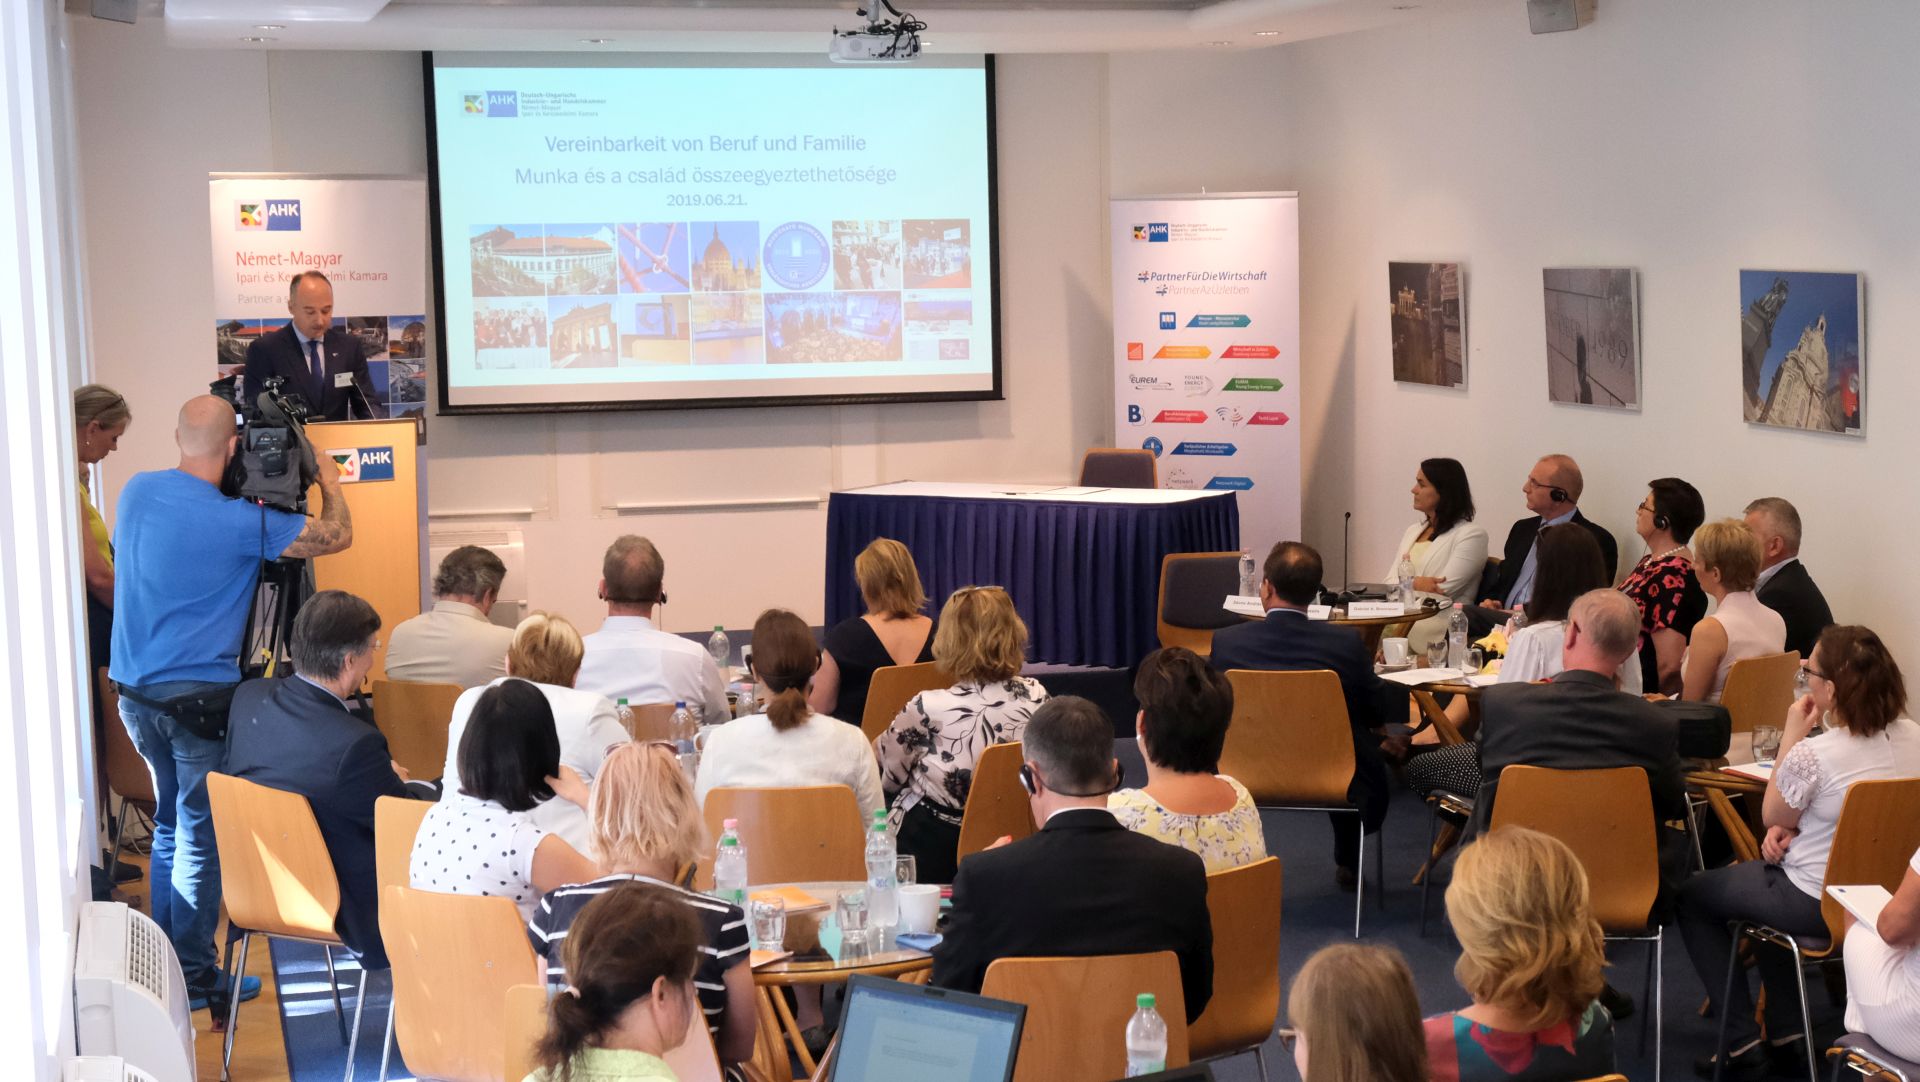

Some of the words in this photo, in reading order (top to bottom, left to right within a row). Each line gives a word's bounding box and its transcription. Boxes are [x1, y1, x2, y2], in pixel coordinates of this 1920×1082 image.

[489, 95, 516, 105] AHK
[544, 135, 667, 154] Vereinbarkeit
[671, 139, 704, 153] von
[709, 134, 758, 152] Beruf
[763, 134, 797, 152] und
[803, 134, 867, 151] Familie
[515, 168, 578, 185] Munka
[584, 166, 606, 184] és
[611, 171, 622, 184] a
[628, 165, 687, 184] család
[692, 164, 897, 188] összeegyeztethetősége
[666, 193, 748, 207] 2019.06.21.
[268, 203, 299, 217] AHK
[1150, 225, 1168, 233] AHK
[236, 250, 344, 269] Német-Magyar
[236, 273, 260, 285] Ipari
[264, 272, 276, 283] és
[350, 271, 388, 281] Kamara
[1150, 270, 1268, 282] PartnerFürDieWirtschaft
[238, 293, 273, 305] Partner
[275, 296, 281, 304] a
[360, 450, 392, 465] AHK
